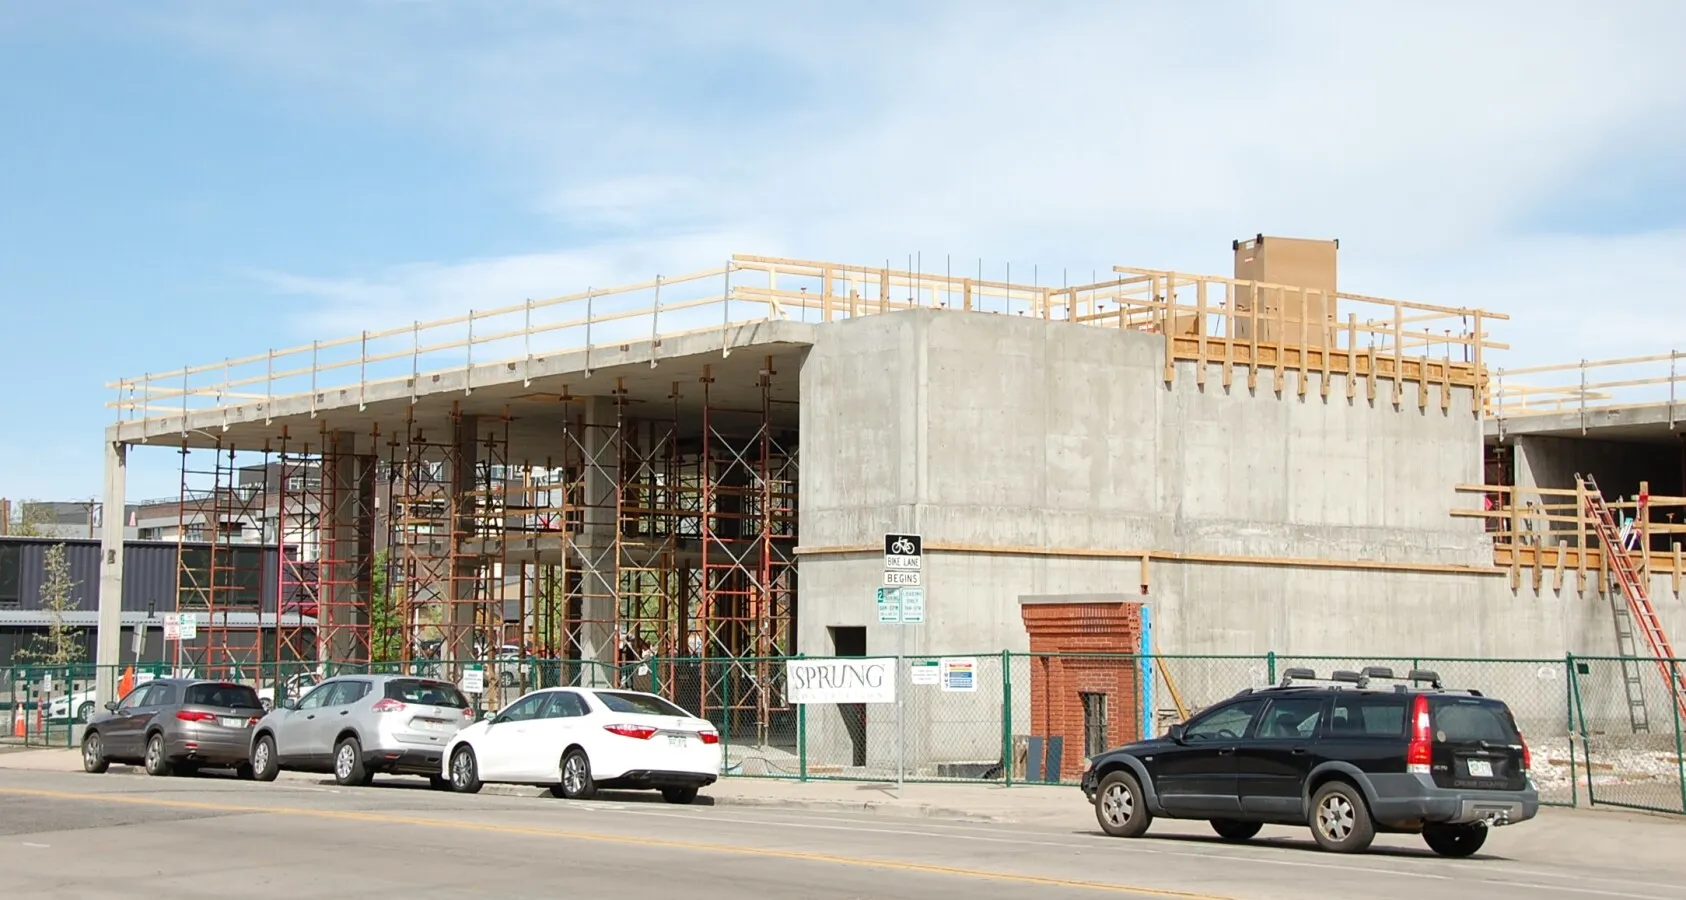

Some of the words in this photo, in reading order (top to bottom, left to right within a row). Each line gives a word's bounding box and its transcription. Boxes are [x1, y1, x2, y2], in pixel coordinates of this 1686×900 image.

[887, 557, 901, 566] BIKE
[903, 557, 919, 567] LANE
[887, 573, 918, 583] BEGINS
[795, 664, 886, 690] SPRUNG
